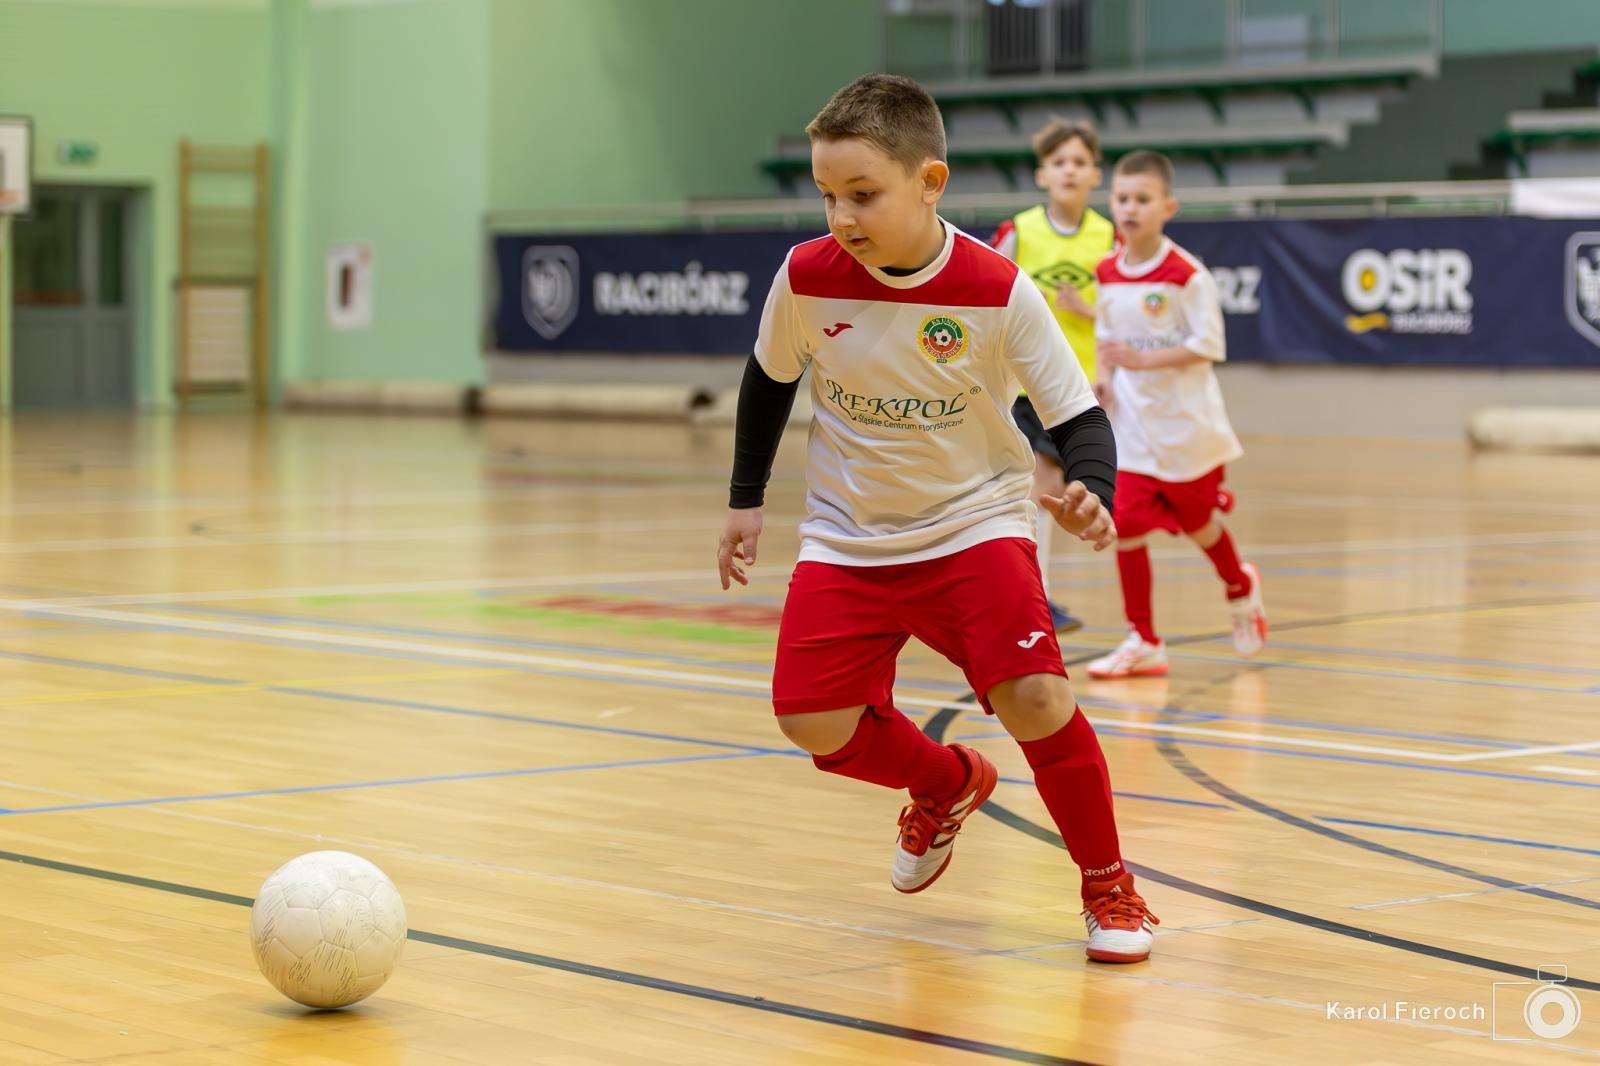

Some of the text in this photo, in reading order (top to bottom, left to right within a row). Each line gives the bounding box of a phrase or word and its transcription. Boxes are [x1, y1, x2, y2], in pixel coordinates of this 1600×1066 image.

[594, 261, 749, 314] RACIBÓRZ
[883, 420, 917, 430] Centrum
[918, 418, 964, 432] Florystyczne
